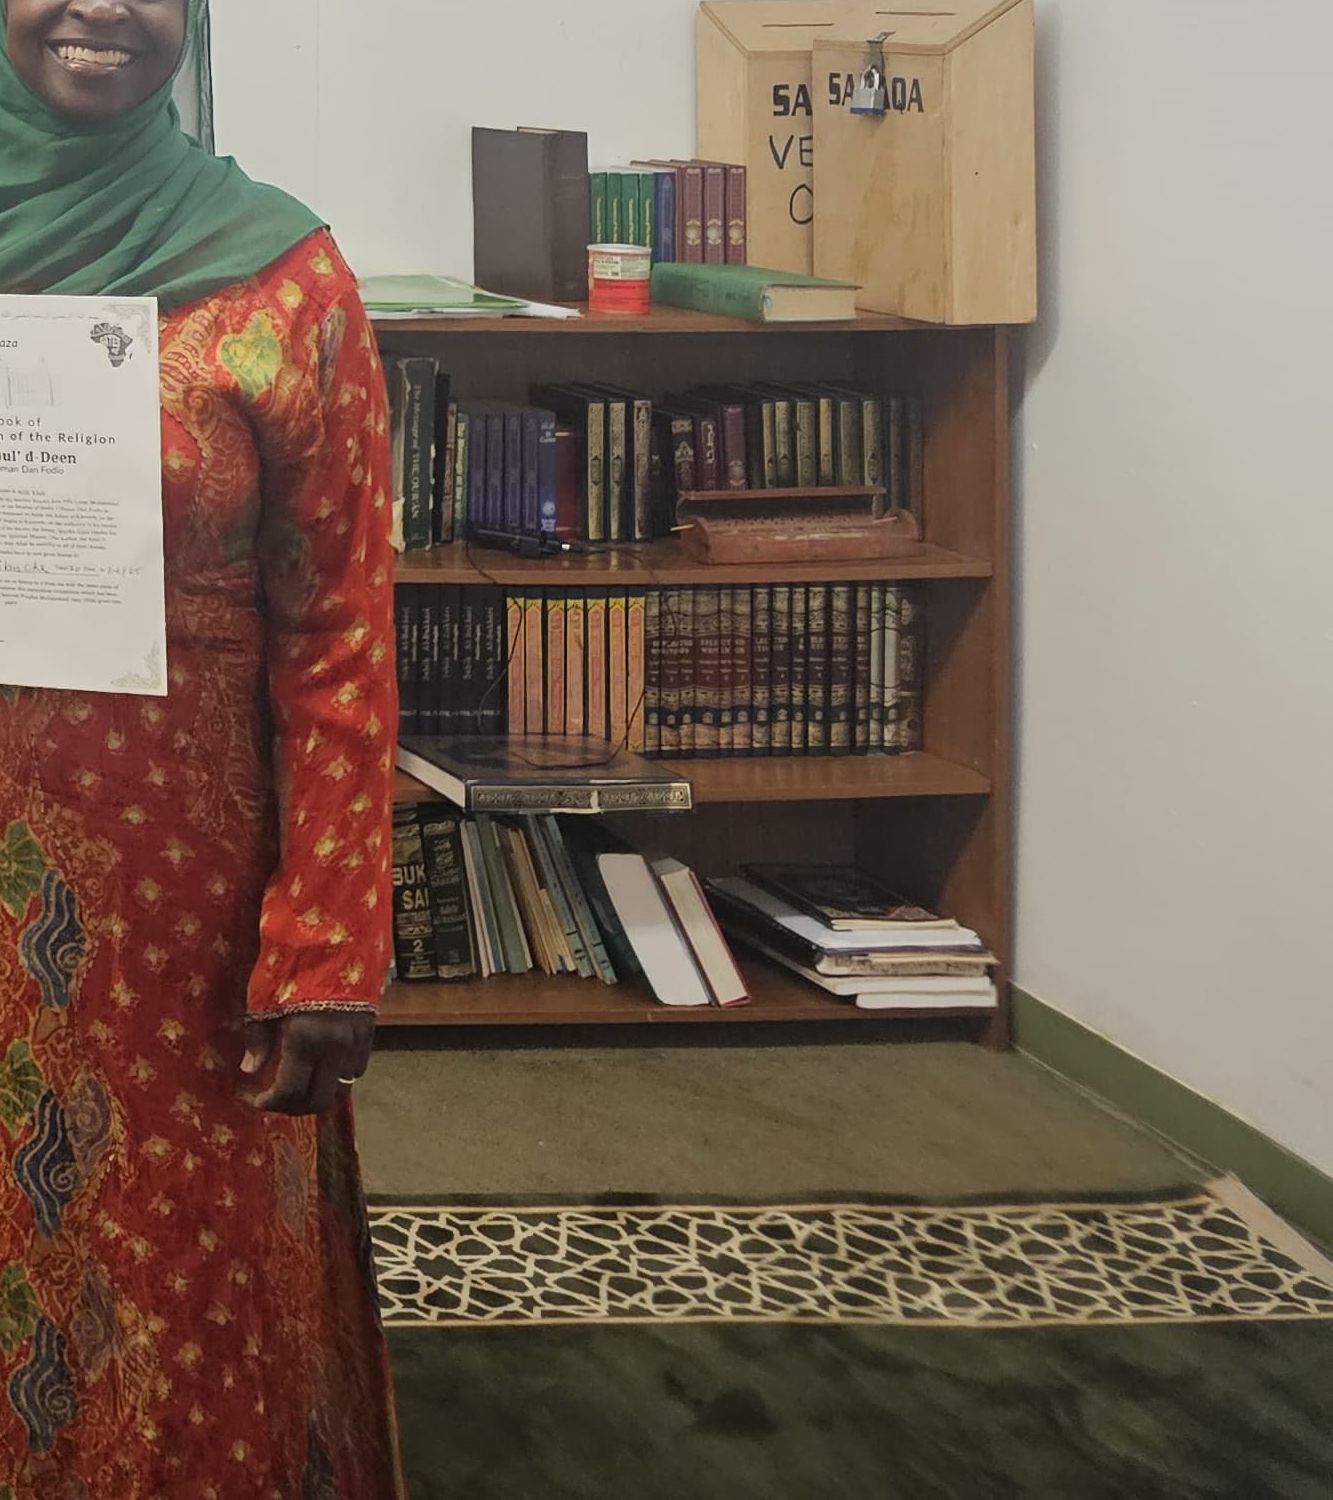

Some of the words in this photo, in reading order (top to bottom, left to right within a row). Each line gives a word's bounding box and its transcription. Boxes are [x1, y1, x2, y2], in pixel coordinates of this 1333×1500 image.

[28, 418, 41, 427] of
[10, 432, 23, 441] of
[29, 432, 51, 442] the
[59, 432, 116, 445] Religion
[21, 466, 39, 474] Dan
[41, 466, 65, 475] Fodio
[413, 939, 423, 953] 2
